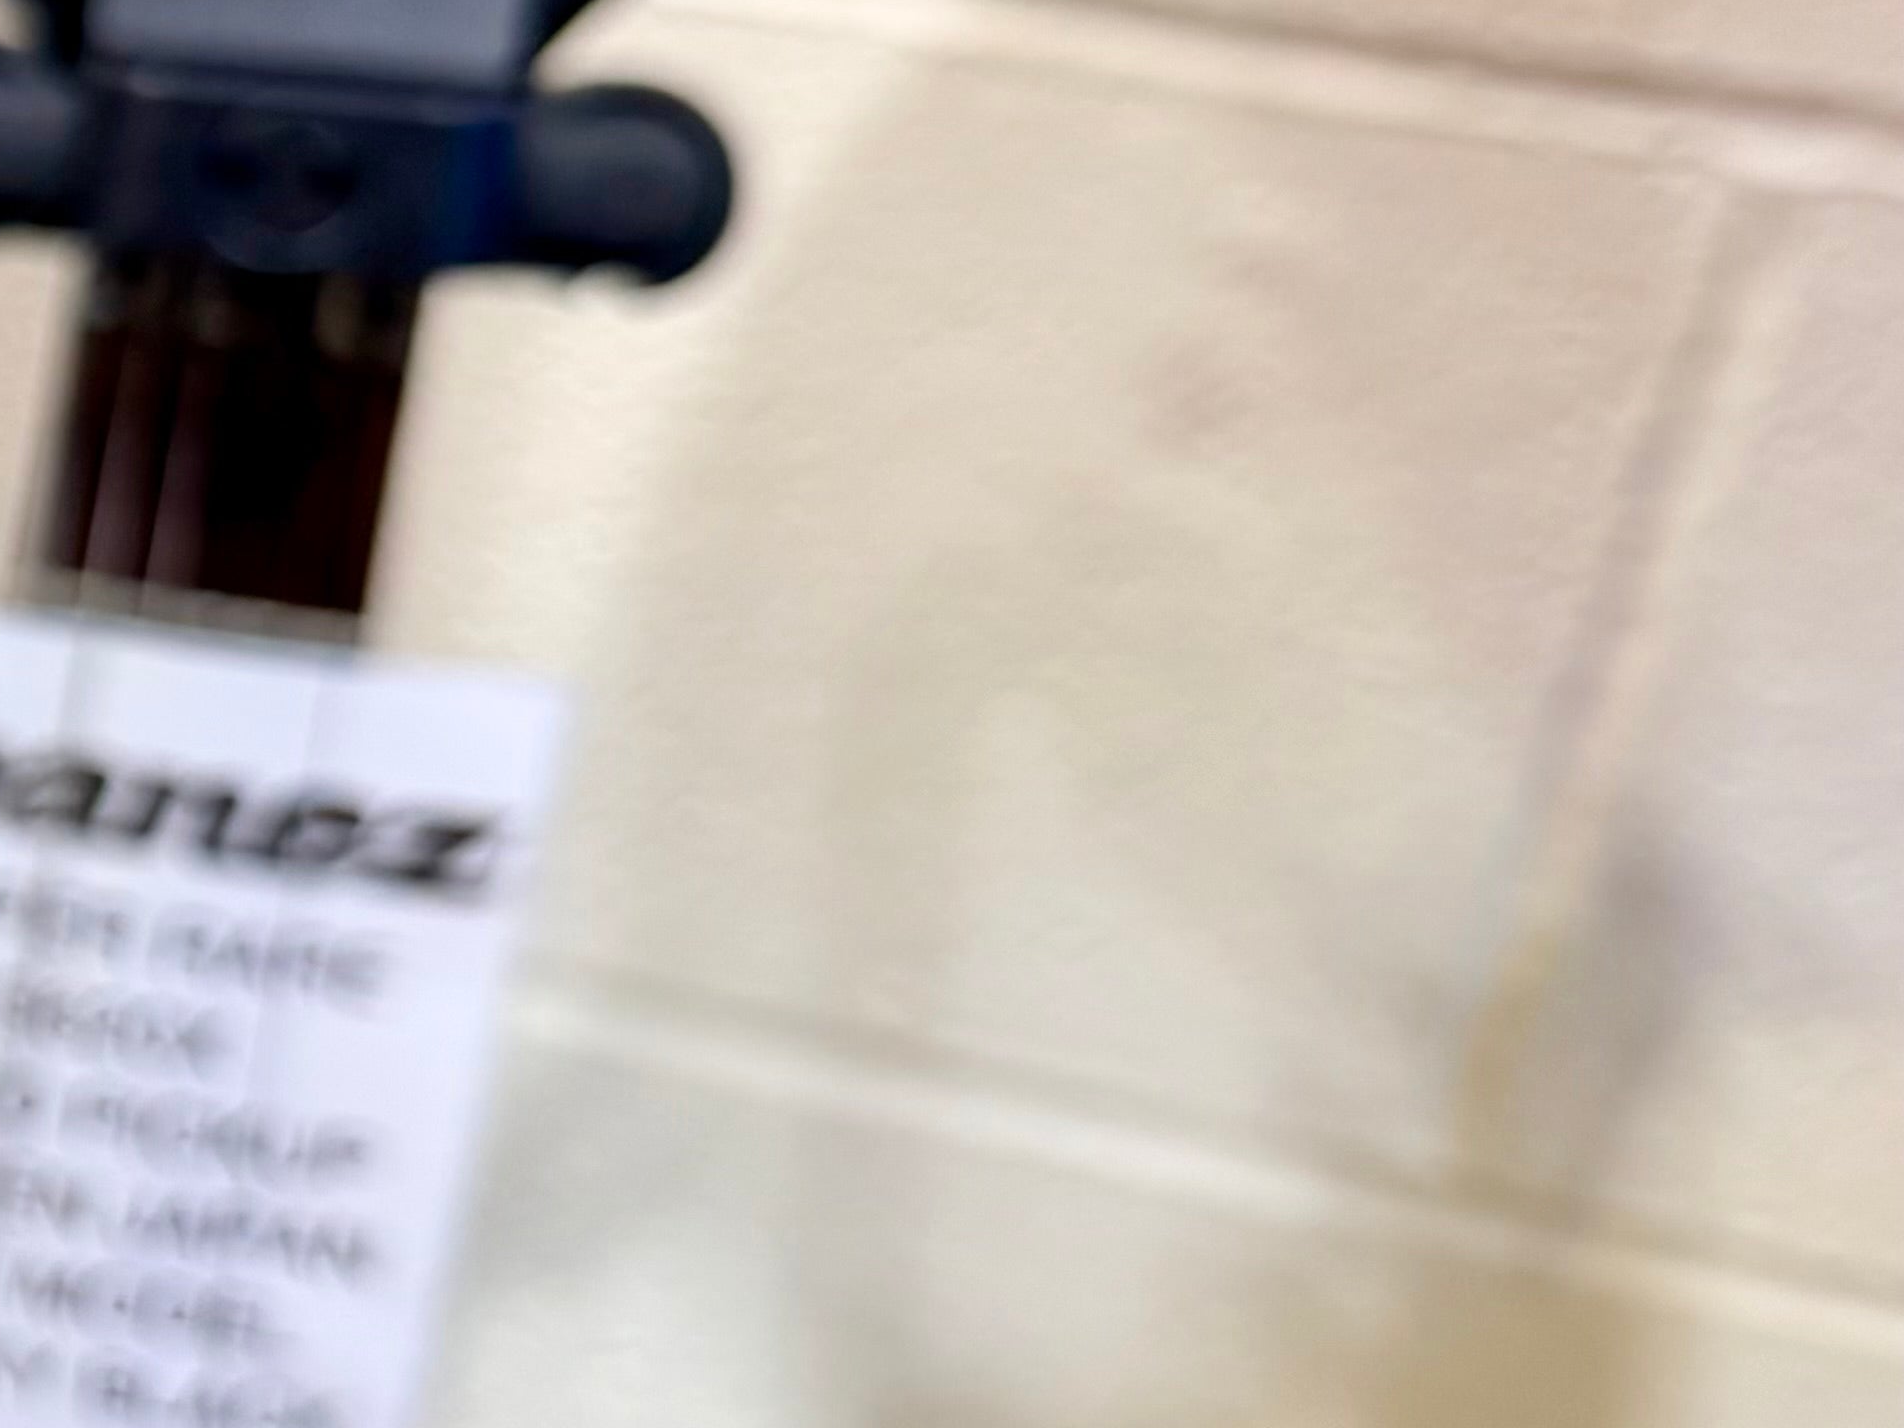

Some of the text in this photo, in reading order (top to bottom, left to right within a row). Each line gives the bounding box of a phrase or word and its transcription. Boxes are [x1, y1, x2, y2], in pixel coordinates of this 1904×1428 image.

[163, 907, 396, 1011] RARE
[71, 1082, 385, 1185] PICKUP
[107, 1187, 385, 1287] JAPAN
[12, 1259, 302, 1361] MODEL
